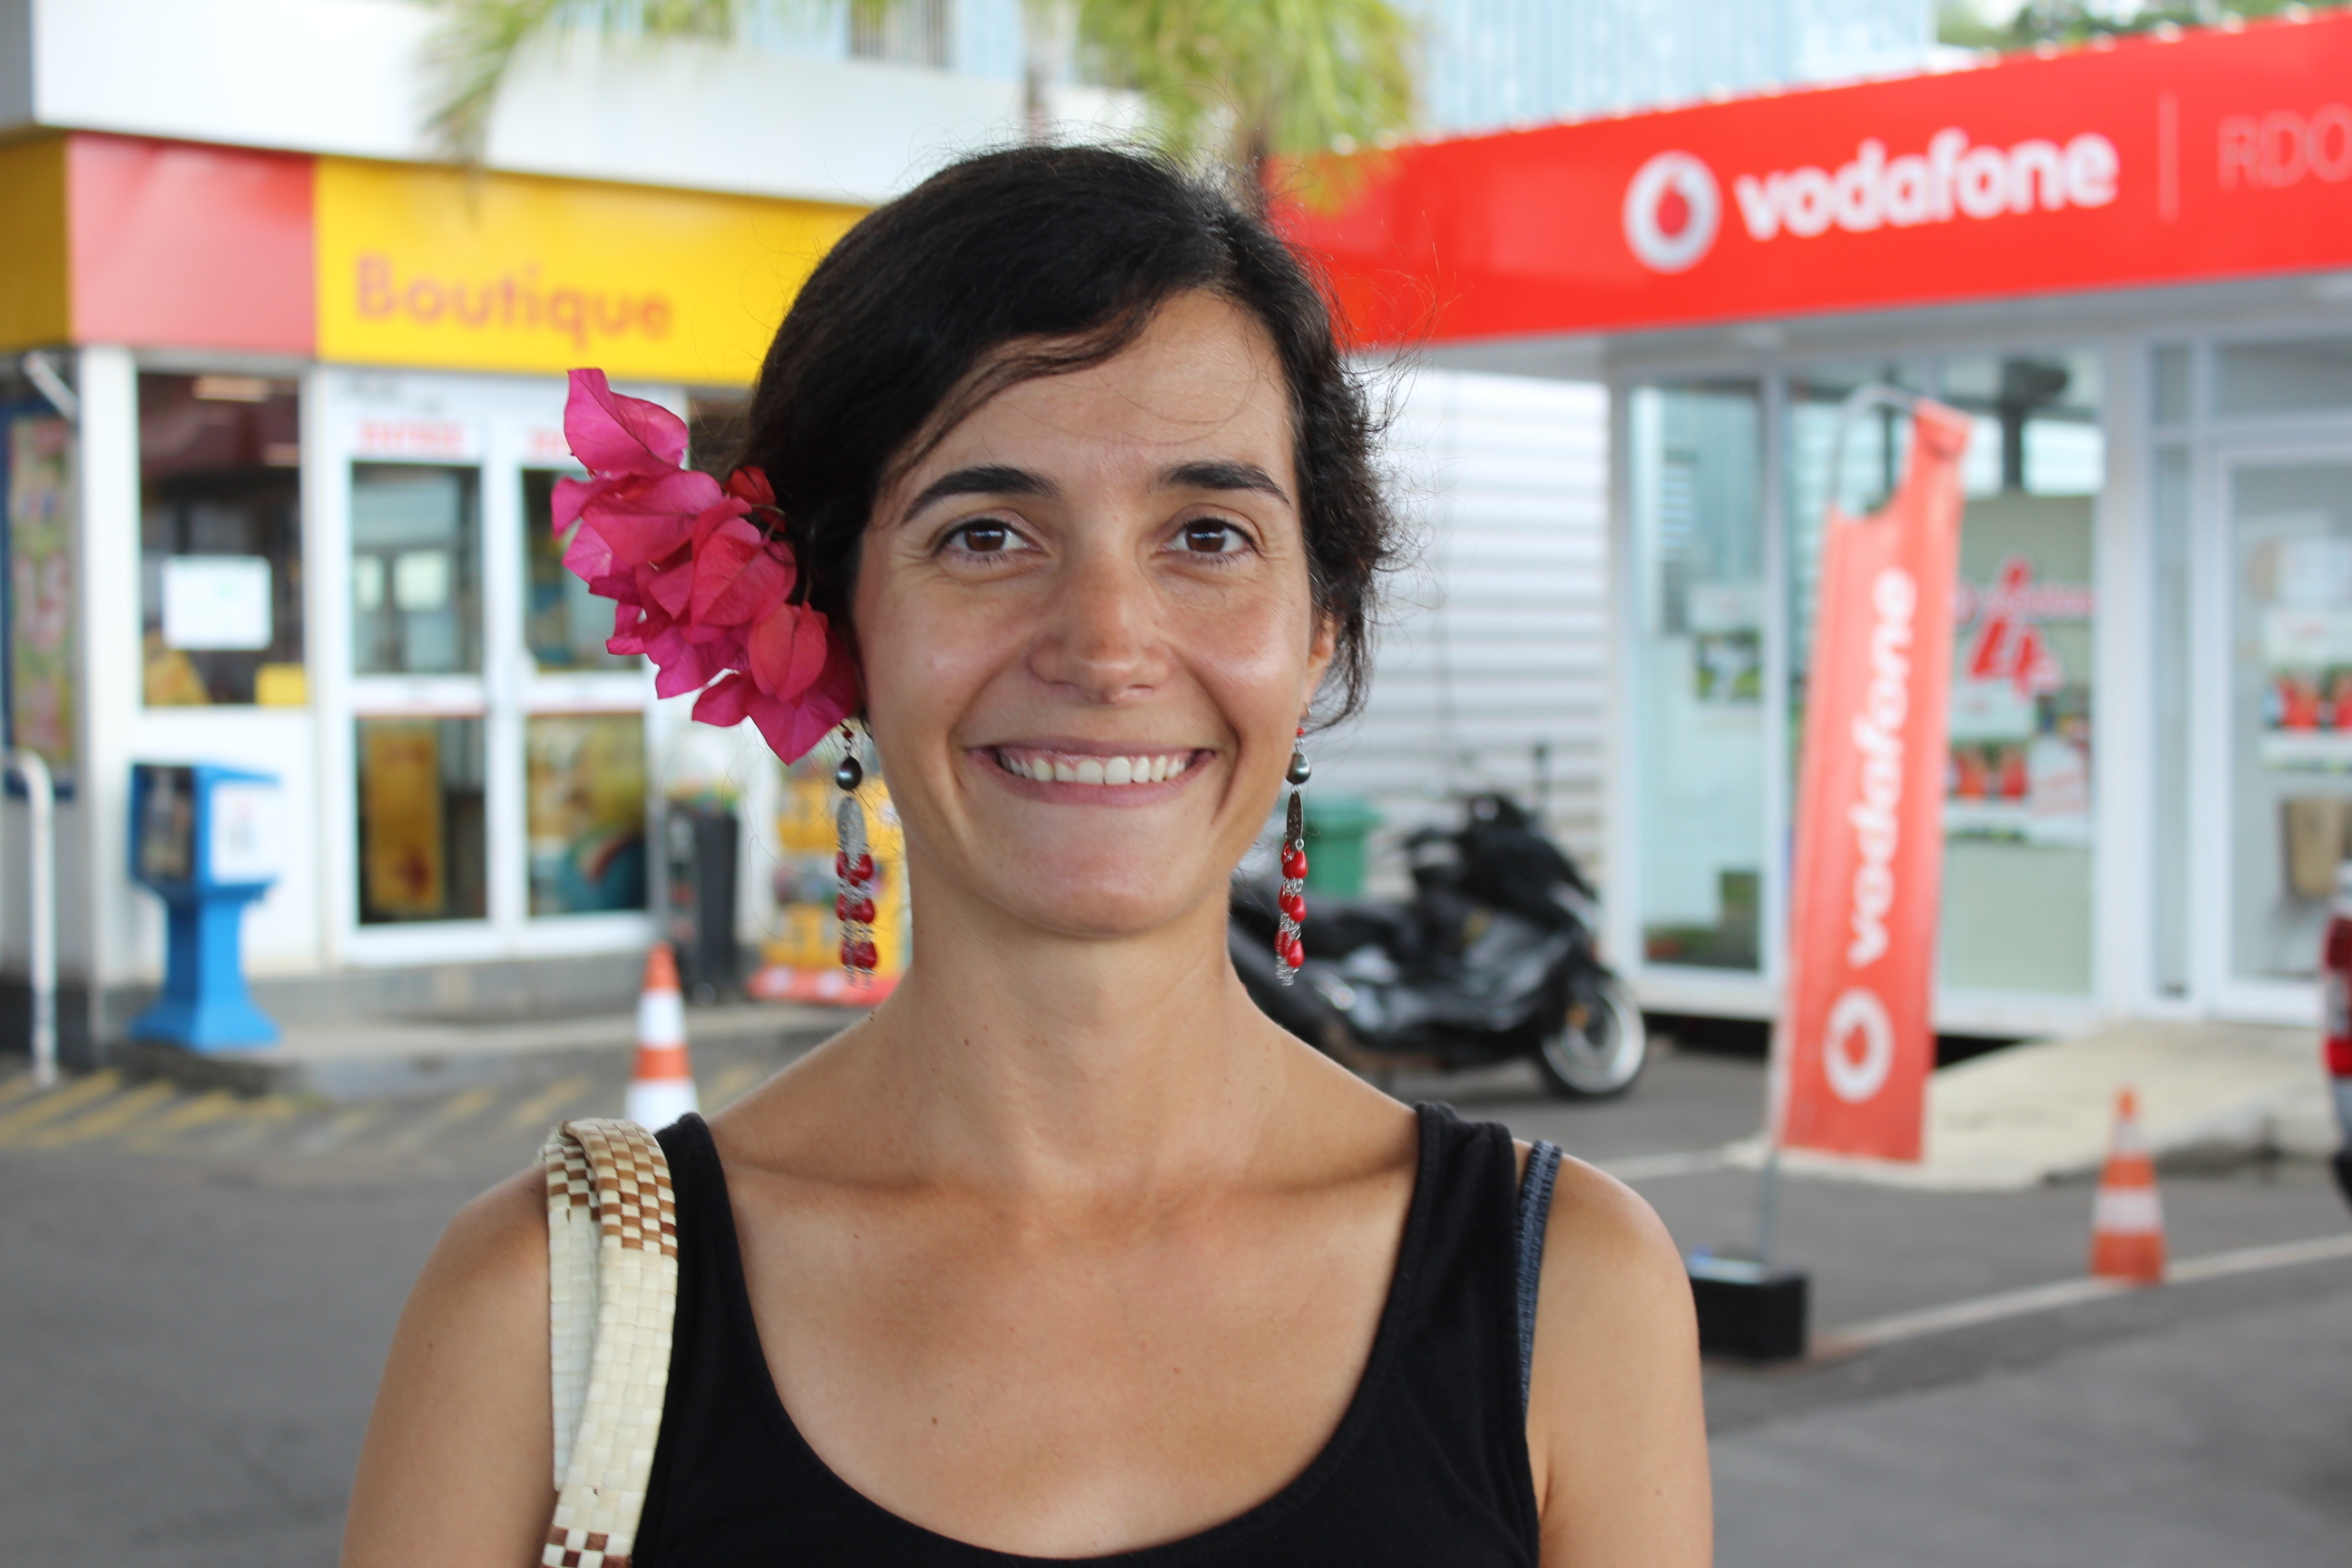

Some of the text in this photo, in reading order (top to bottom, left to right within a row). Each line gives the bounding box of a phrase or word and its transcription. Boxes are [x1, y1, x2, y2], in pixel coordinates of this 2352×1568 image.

[1734, 129, 2118, 240] vodafone
[356, 255, 672, 354] Boutique
[1847, 569, 1916, 966] vodafone
